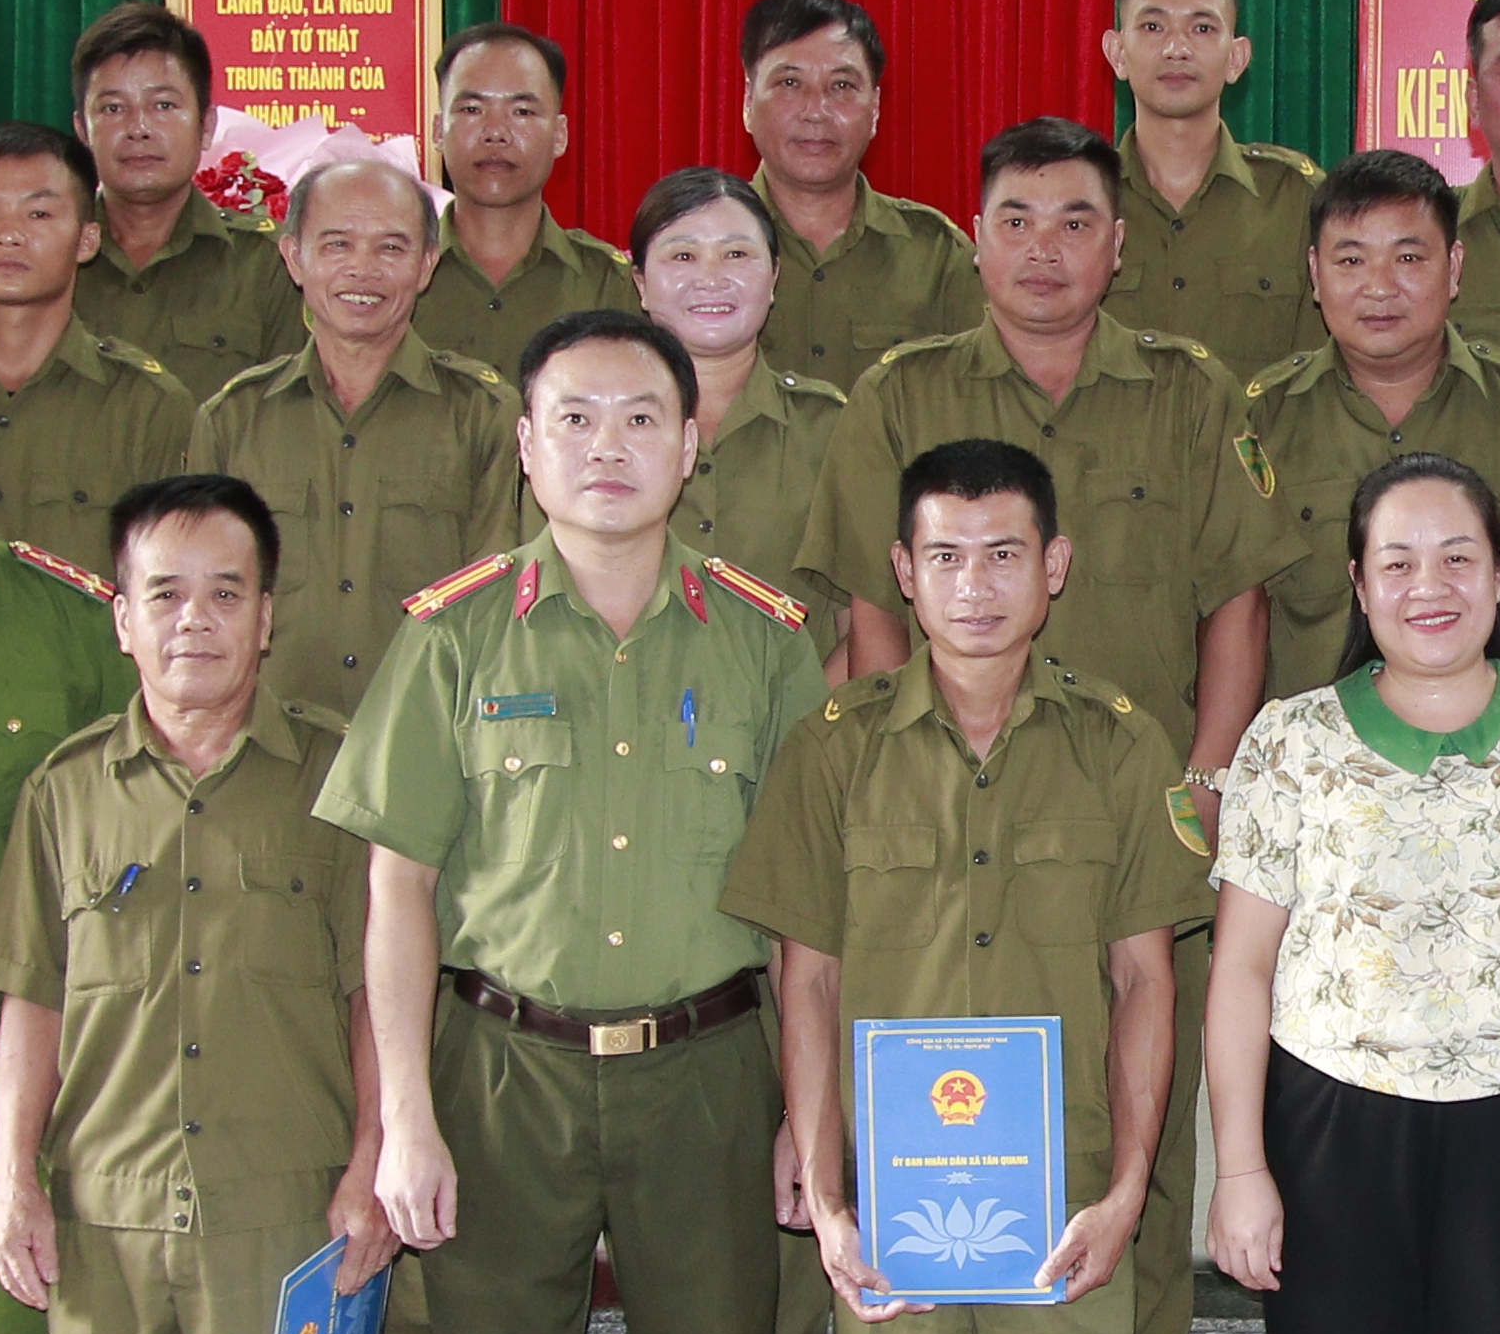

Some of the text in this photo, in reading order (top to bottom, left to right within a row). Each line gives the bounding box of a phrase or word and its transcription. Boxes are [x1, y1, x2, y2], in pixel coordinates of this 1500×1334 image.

[289, 23, 314, 53] TỚ
[316, 23, 360, 57] THẬT
[224, 57, 385, 91] TRUNG THÀNH CỦA
